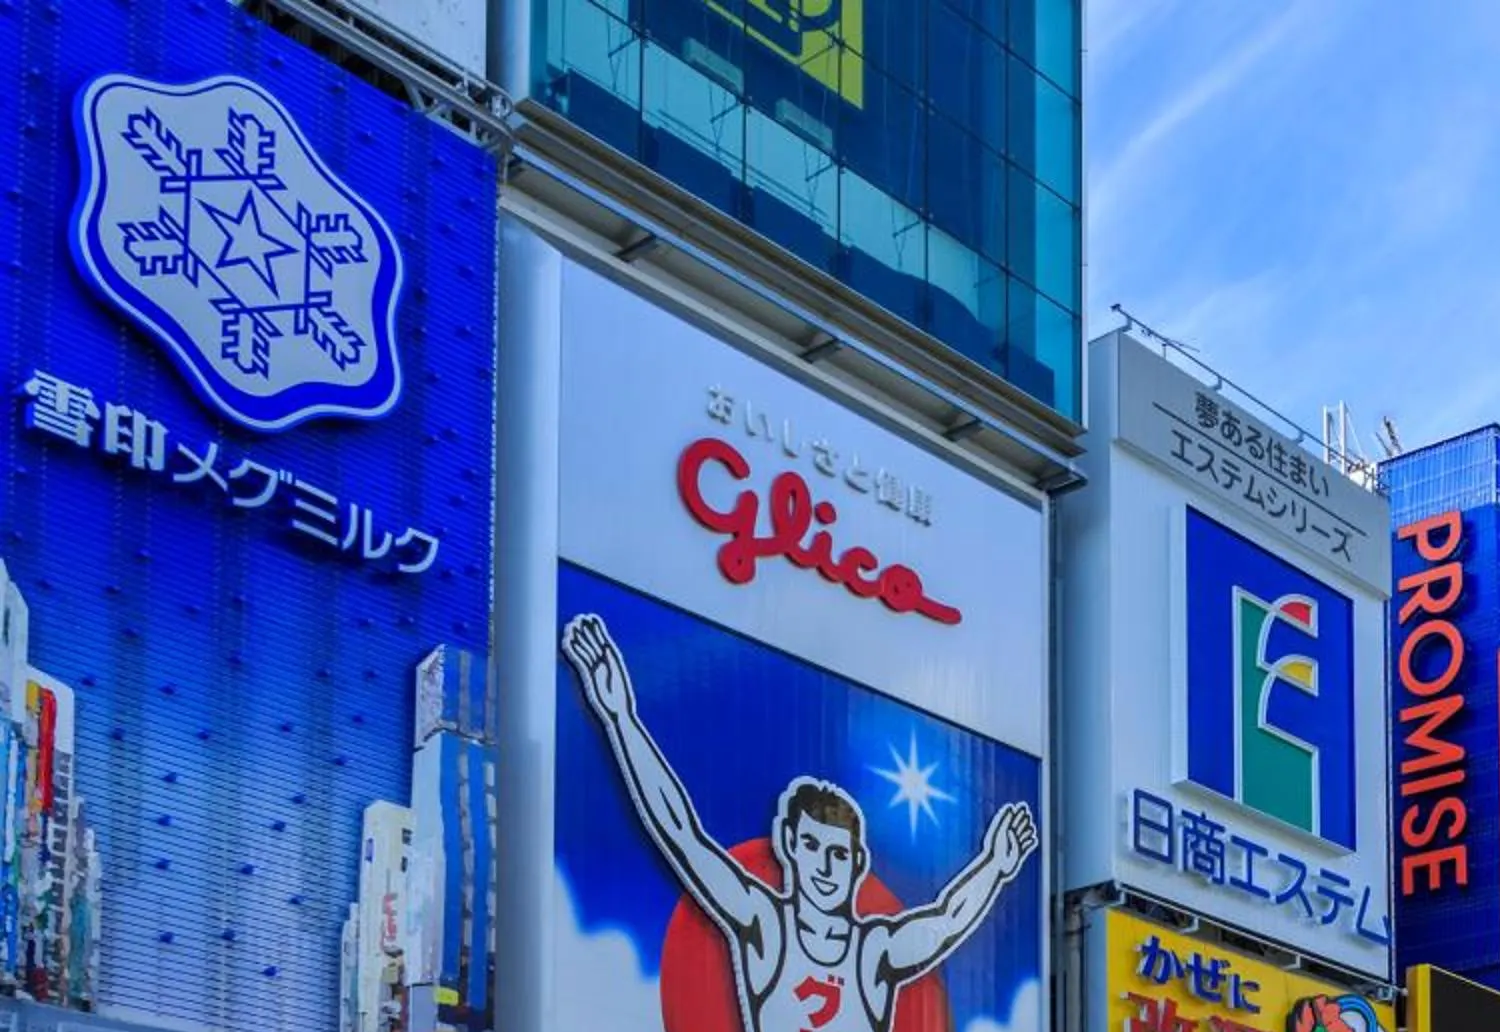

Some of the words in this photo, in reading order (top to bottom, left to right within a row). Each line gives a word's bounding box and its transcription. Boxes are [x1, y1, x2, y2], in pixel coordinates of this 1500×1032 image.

[25, 369, 439, 574] 雪印メグミルク
[1194, 391, 1329, 498] 夢ある住まい
[677, 437, 962, 625] Glico
[1398, 511, 1468, 896] PROMISE
[1131, 788, 1390, 945] 日商エステム
[1138, 936, 1262, 1015] かぜに
